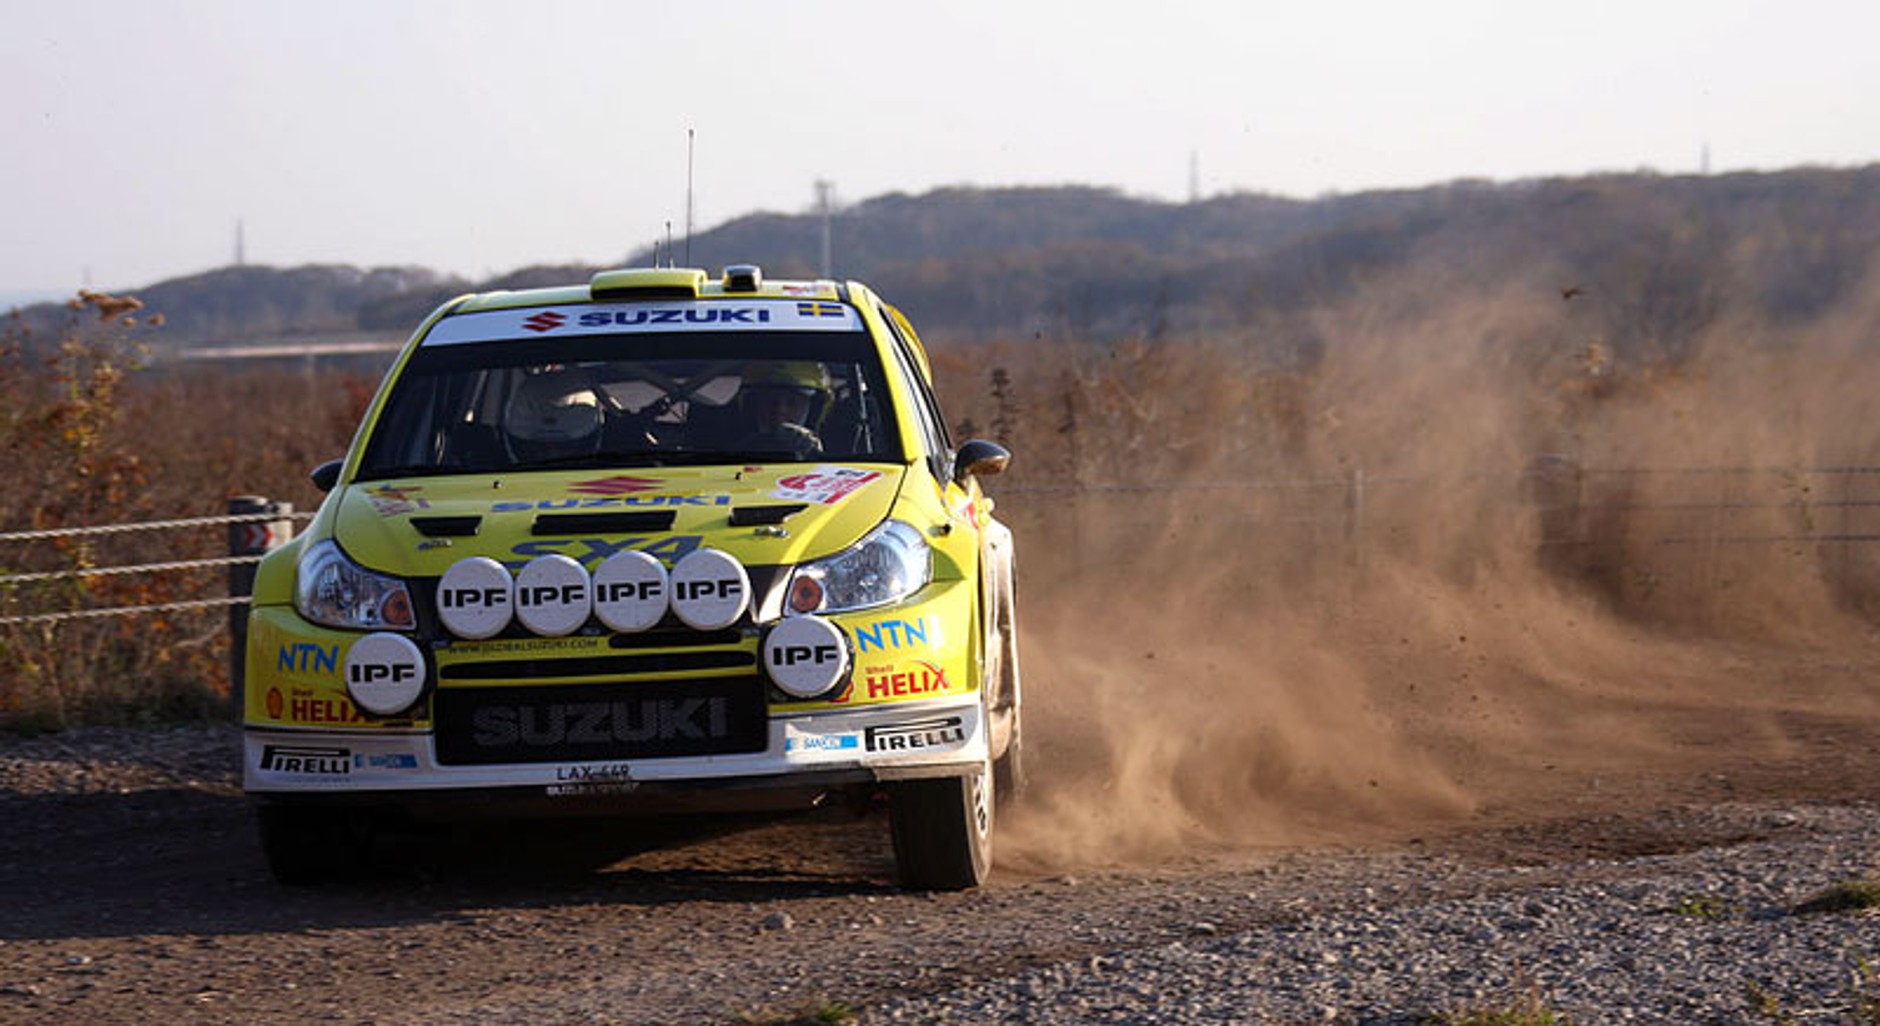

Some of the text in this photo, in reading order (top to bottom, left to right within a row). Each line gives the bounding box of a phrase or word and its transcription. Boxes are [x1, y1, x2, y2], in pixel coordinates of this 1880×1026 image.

[578, 308, 770, 327] SUZUKI
[490, 495, 731, 513] SUZUKI
[511, 535, 704, 569] SX4
[442, 588, 507, 608] IPF
[519, 584, 585, 607] IPF
[596, 580, 662, 603] IPF
[676, 579, 743, 601] IPF
[854, 617, 928, 654] NTN
[277, 642, 339, 674] NTN
[772, 644, 839, 666] IPF
[351, 663, 416, 683] IPF
[866, 665, 951, 699] HELIX
[472, 697, 729, 747] SUZUKI
[864, 715, 966, 752] PIRELLI
[260, 743, 351, 775] PIRELLI
